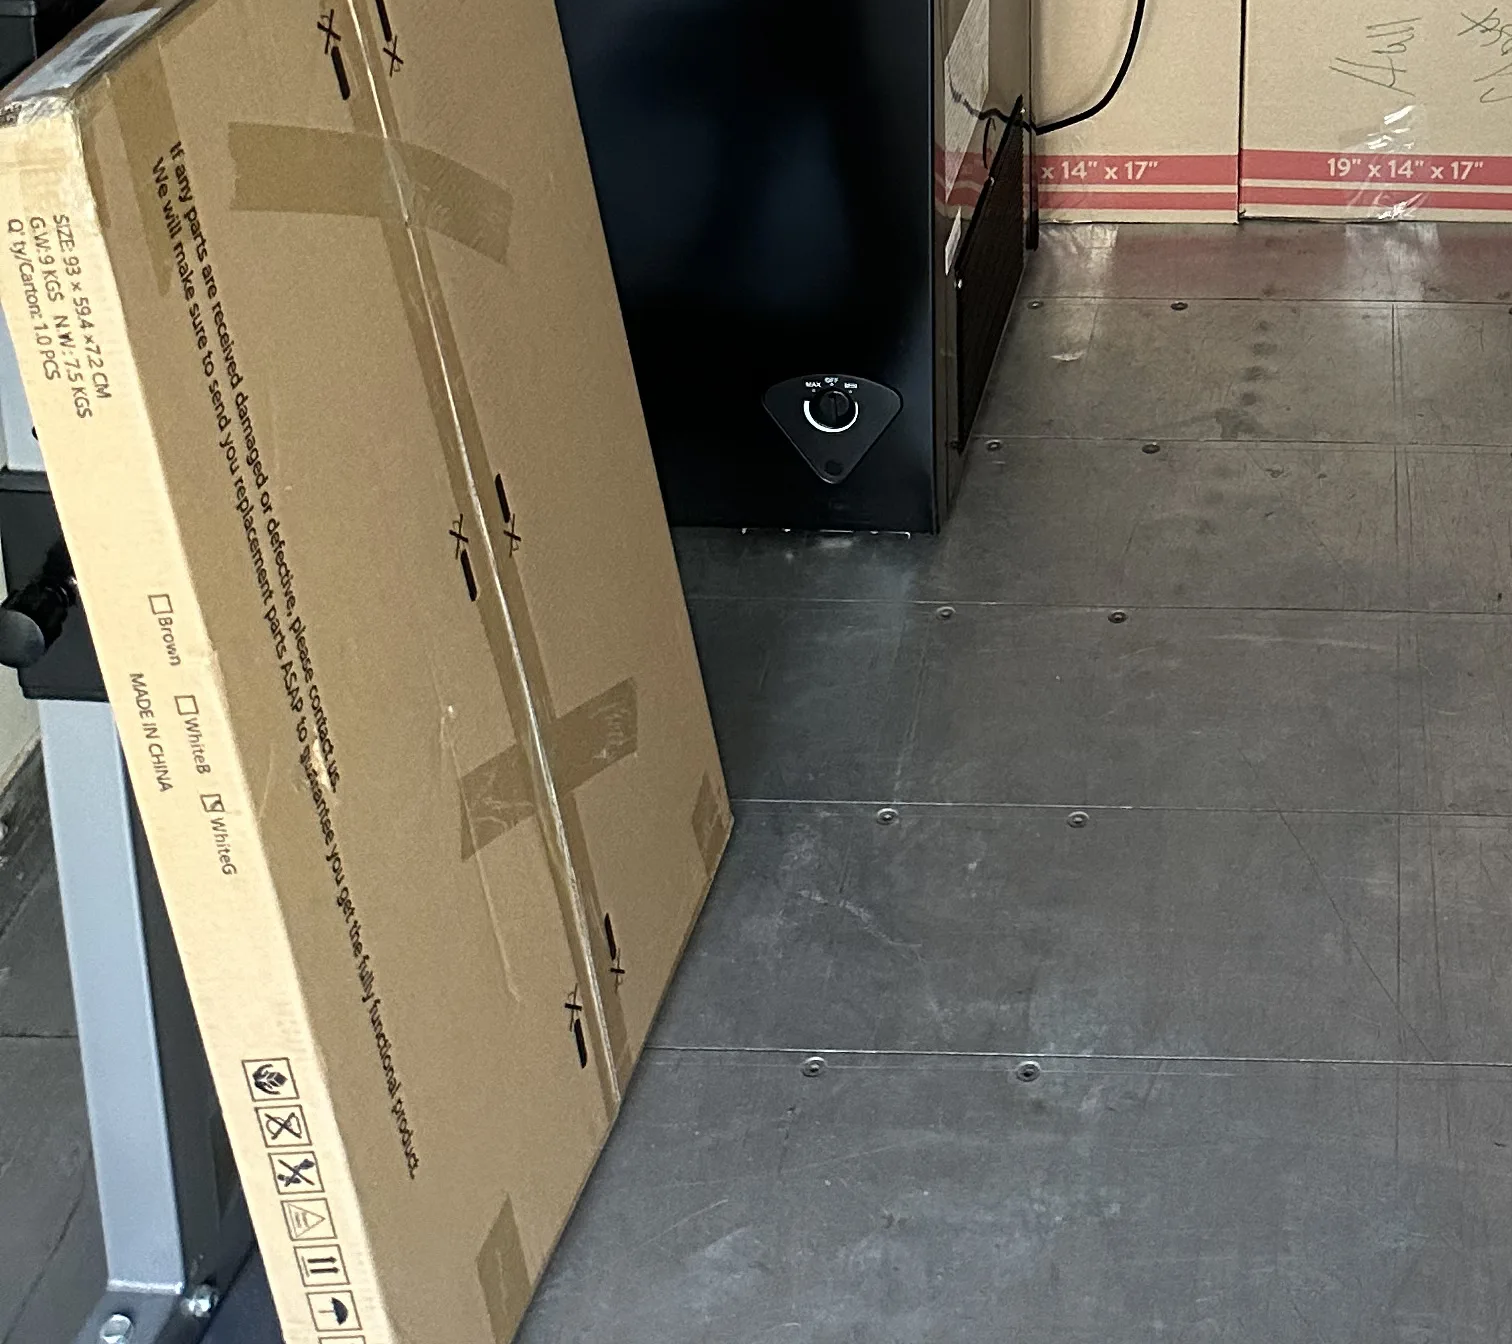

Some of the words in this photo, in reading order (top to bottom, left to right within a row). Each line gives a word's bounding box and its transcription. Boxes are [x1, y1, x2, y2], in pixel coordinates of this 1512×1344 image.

[169, 141, 185, 161] If
[152, 156, 169, 199] We
[175, 163, 194, 203] any
[53, 214, 75, 253] SIZE:
[162, 199, 182, 240] will
[184, 206, 208, 262] parts
[63, 256, 82, 276] 93
[71, 281, 82, 292] x
[173, 241, 196, 302] make
[201, 264, 218, 300] are
[33, 323, 52, 346] 1.0
[73, 297, 94, 330] 59.4
[189, 303, 209, 350] sure
[40, 350, 62, 381] PCS
[41, 269, 65, 303] KGS
[71, 386, 93, 419] KGS
[202, 349, 216, 378] to
[212, 300, 244, 390] received
[92, 372, 113, 399] CM
[208, 379, 232, 432] send
[219, 431, 241, 476] you
[235, 391, 269, 490] damaged
[260, 492, 273, 515] or
[234, 475, 274, 606] replacement
[266, 518, 297, 617] defective,
[158, 616, 181, 667] Brown
[264, 604, 287, 660] parts
[289, 616, 315, 684] please
[129, 672, 154, 720] MADE
[280, 660, 304, 714] ASAP
[143, 723, 161, 740] IN
[296, 715, 308, 743] to
[308, 684, 334, 755] contact
[148, 744, 173, 793] CHINA
[184, 717, 211, 774] WhiteB
[300, 744, 335, 846] guarantee
[210, 816, 238, 876] WhiteG
[325, 843, 345, 887] you
[336, 886, 356, 924] get
[349, 919, 364, 957] the
[357, 954, 375, 1004] fully
[368, 998, 402, 1099] functional
[391, 1100, 420, 1180] product.
